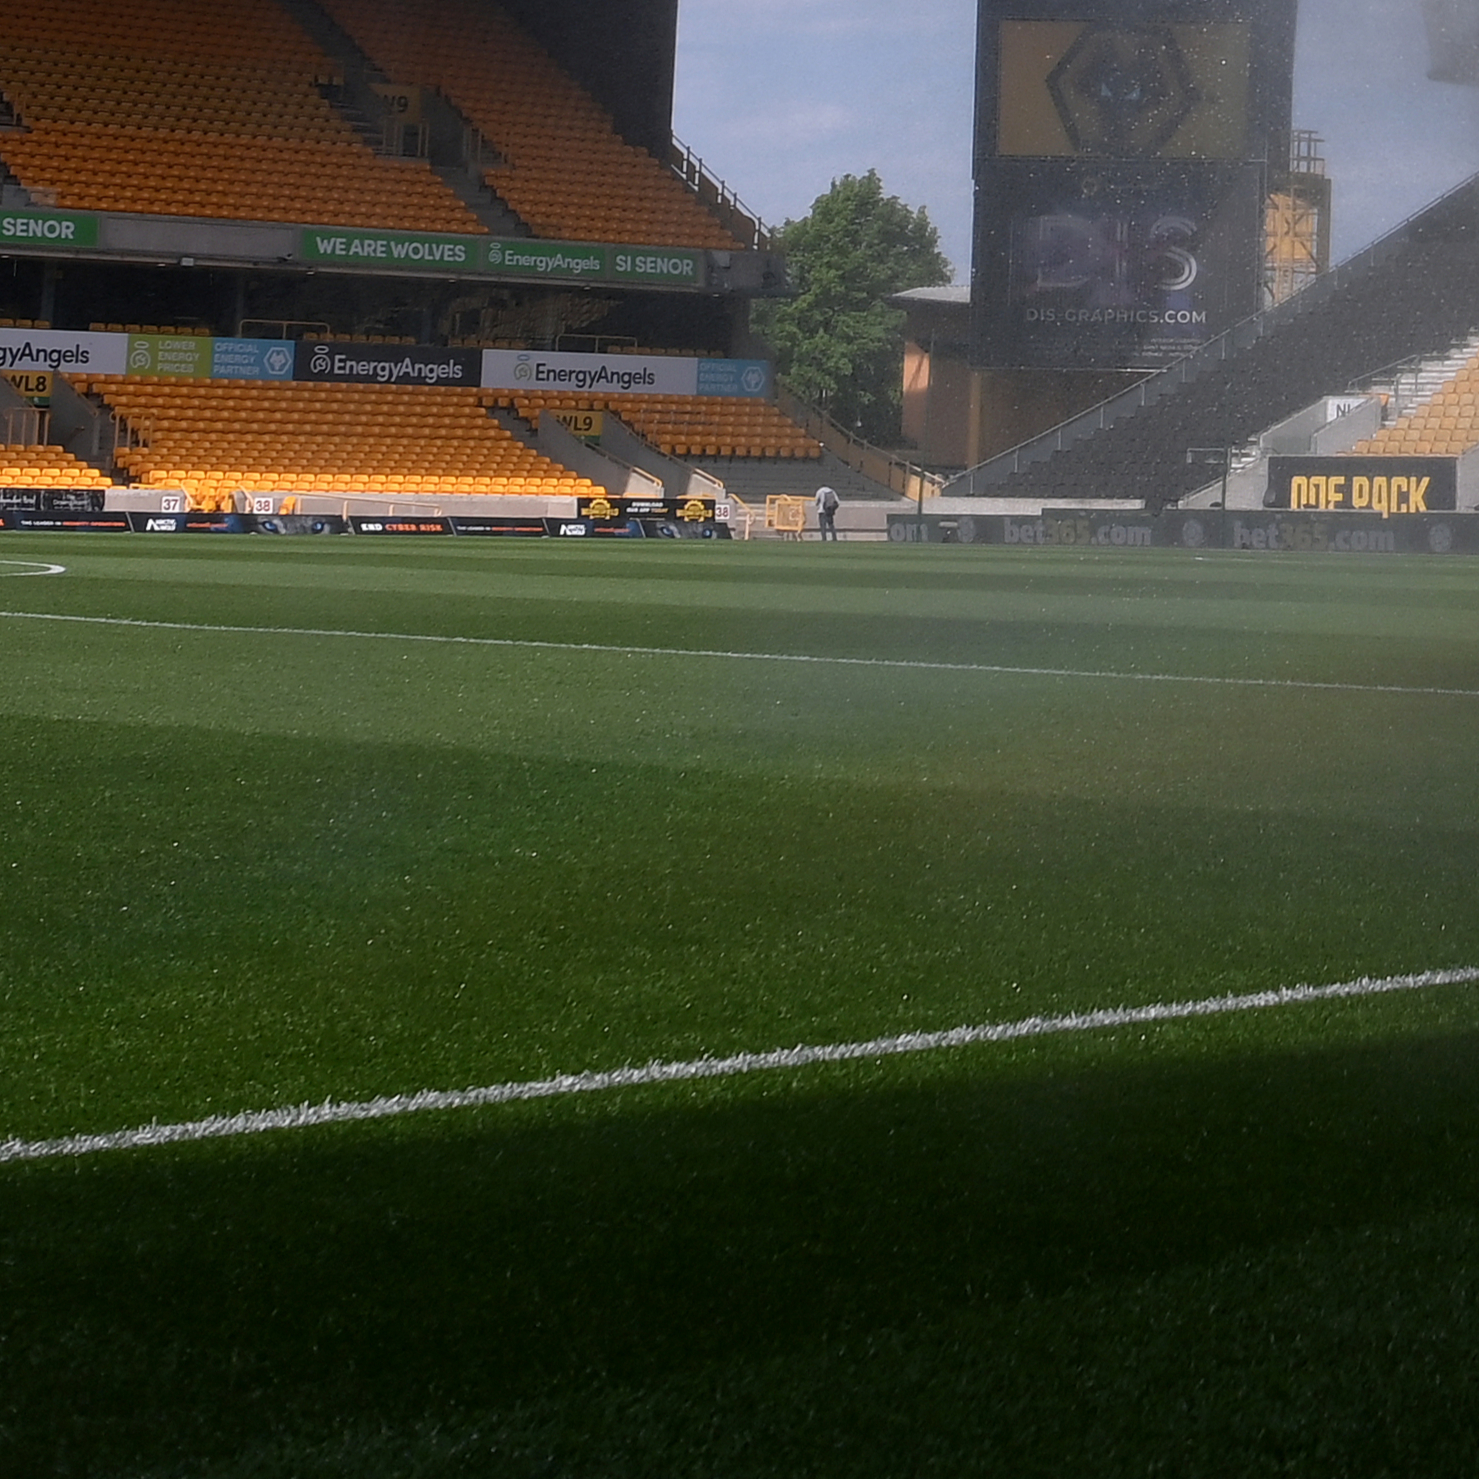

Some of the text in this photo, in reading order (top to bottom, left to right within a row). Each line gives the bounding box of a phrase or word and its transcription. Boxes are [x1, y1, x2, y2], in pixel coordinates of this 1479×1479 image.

[1, 217, 75, 240] SENOR
[316, 236, 466, 262] WE ARE WOLVES
[504, 250, 601, 272] EnergyAngels
[615, 255, 693, 276] SI SENOR
[1026, 307, 1207, 325] DIS-GRAPHICS.COM
[158, 340, 196, 350] LOWER
[214, 342, 259, 353] OFFICIAL
[158, 351, 199, 362] ENERGY
[214, 353, 255, 364] ENERGY
[157, 363, 195, 373] PRICES
[213, 364, 259, 375] PARTNER
[333, 354, 463, 384] EnergyAngels
[535, 363, 656, 390] EnergyAngels
[1351, 475, 1431, 513] PACK
[162, 498, 179, 511] 37
[255, 500, 271, 512] 38
[715, 506, 730, 518] 38
[1003, 518, 1152, 547] bet365.com
[1233, 521, 1395, 552] bet365.com
